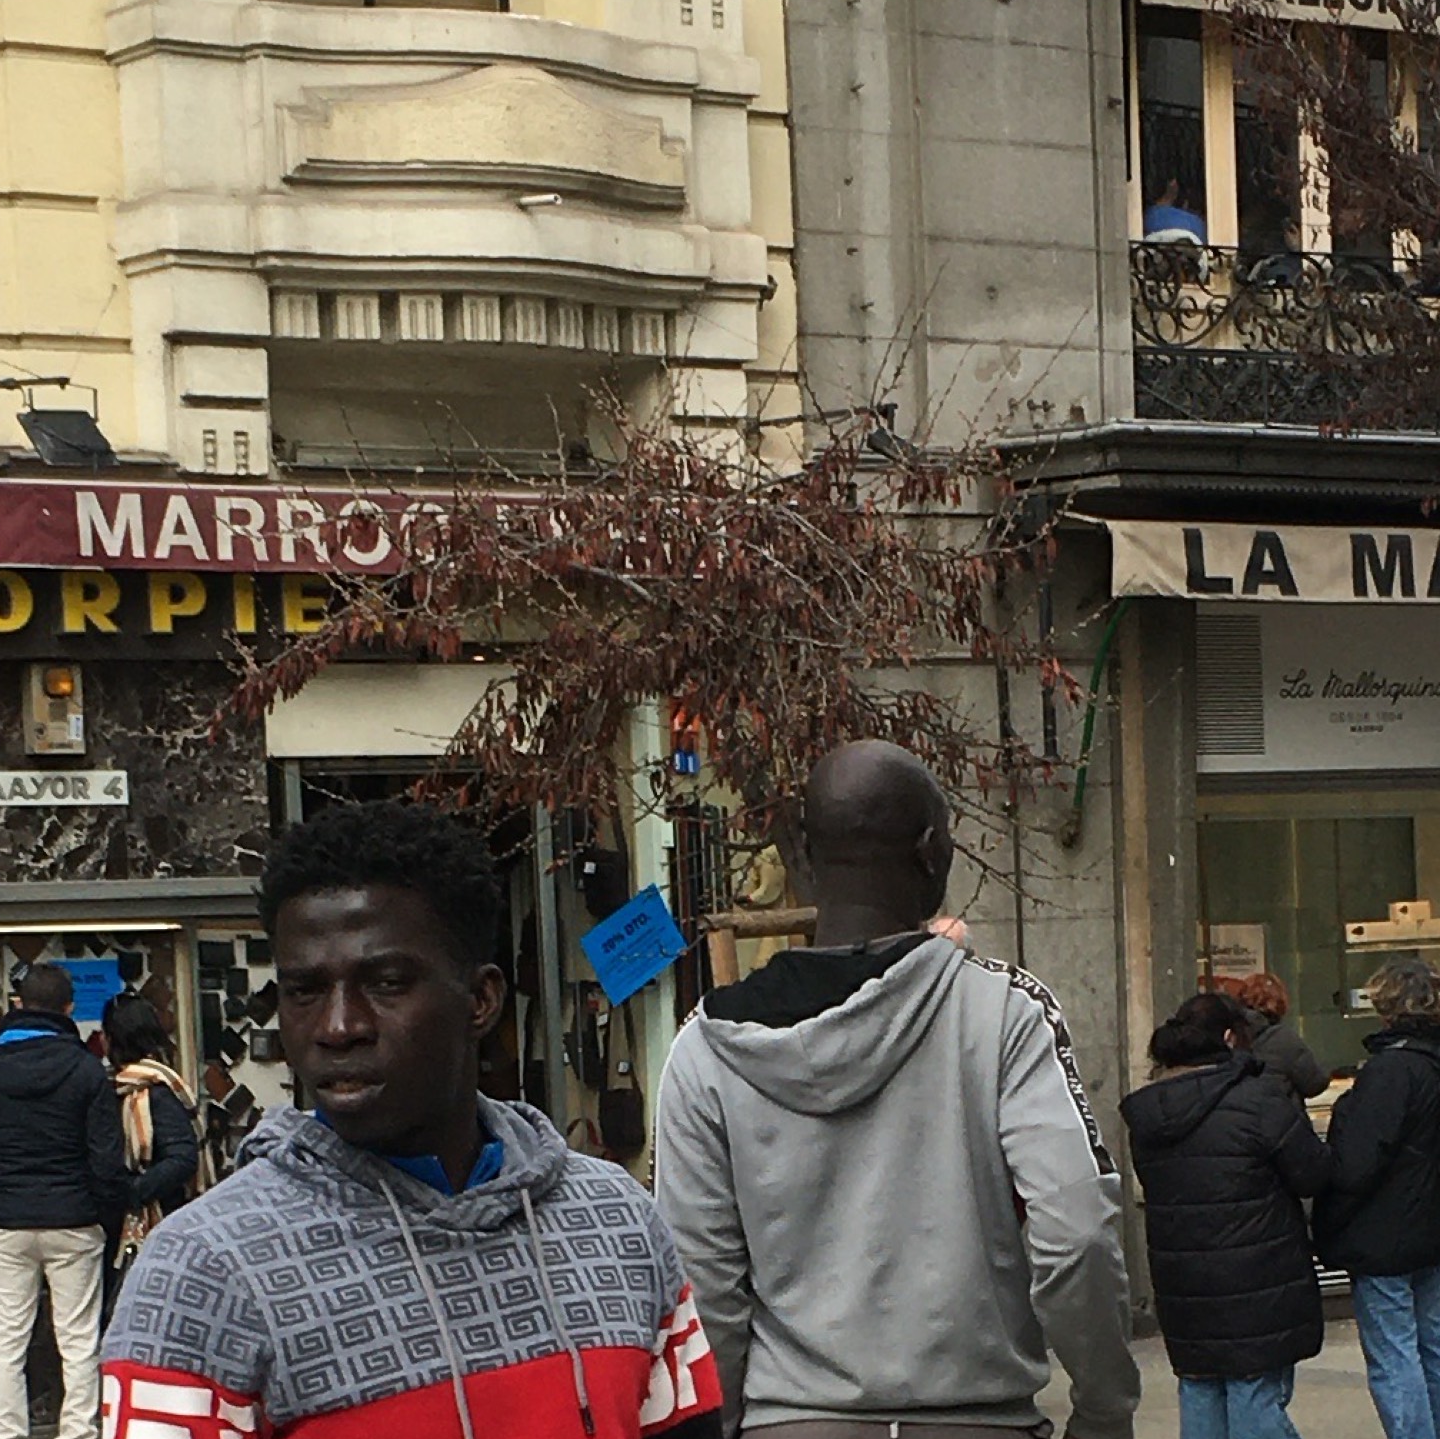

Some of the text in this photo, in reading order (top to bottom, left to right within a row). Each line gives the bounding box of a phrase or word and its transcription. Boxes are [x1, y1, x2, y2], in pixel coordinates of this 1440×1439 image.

[1183, 528, 1298, 596] LA
[1279, 668, 1314, 699] La
[103, 775, 123, 801] 4
